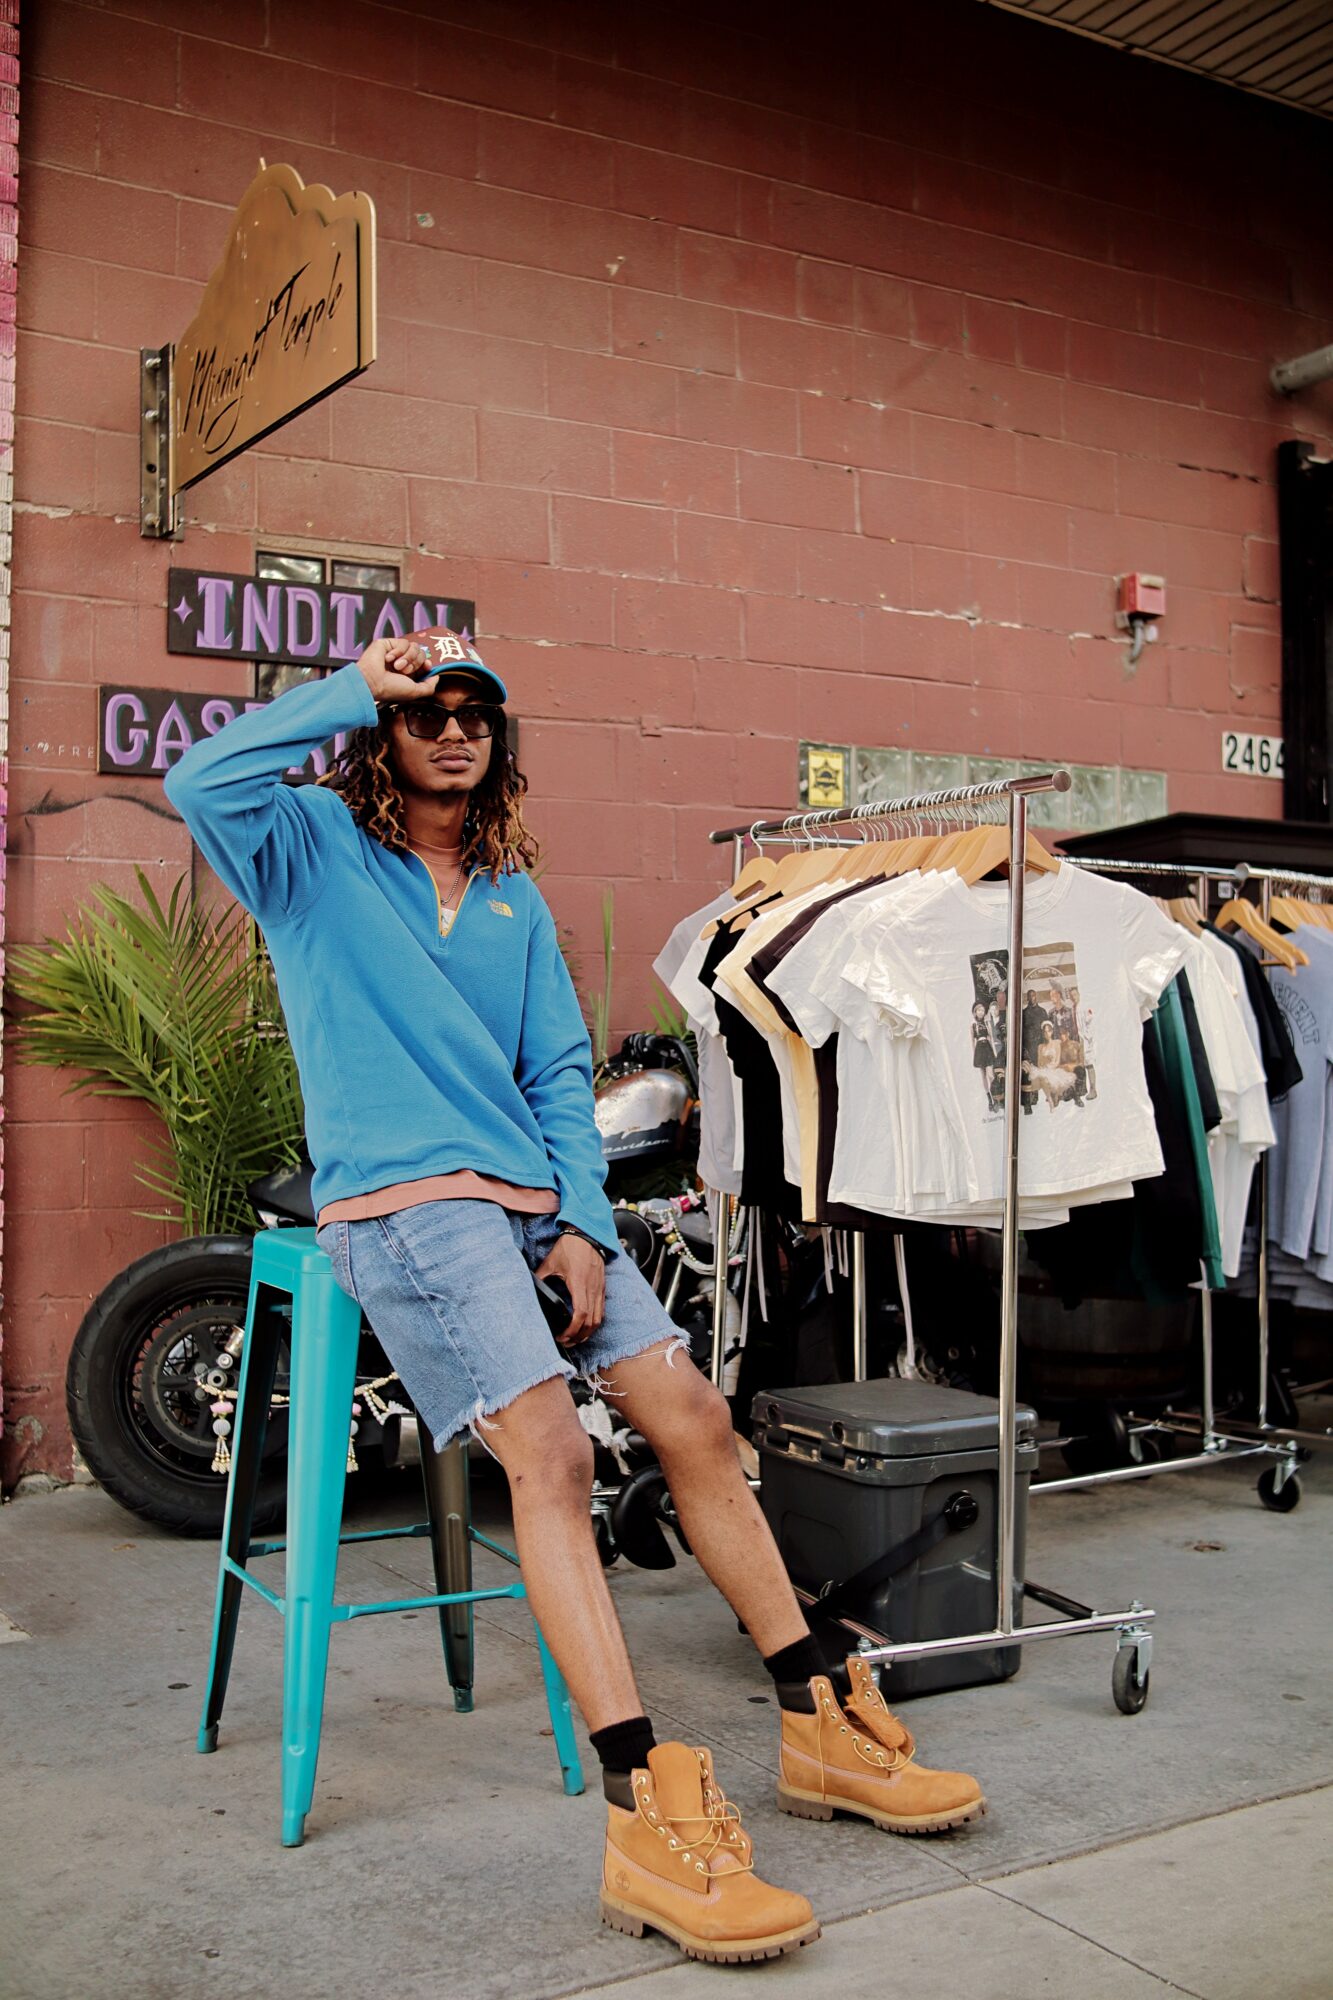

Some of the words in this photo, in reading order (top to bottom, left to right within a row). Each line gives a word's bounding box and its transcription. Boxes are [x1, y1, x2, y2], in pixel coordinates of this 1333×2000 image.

[184, 299, 282, 454] Midnight
[274, 252, 343, 363] Temple
[429, 634, 466, 662] D
[1226, 734, 1286, 773] 2464
[602, 1138, 671, 1155] Davidson
